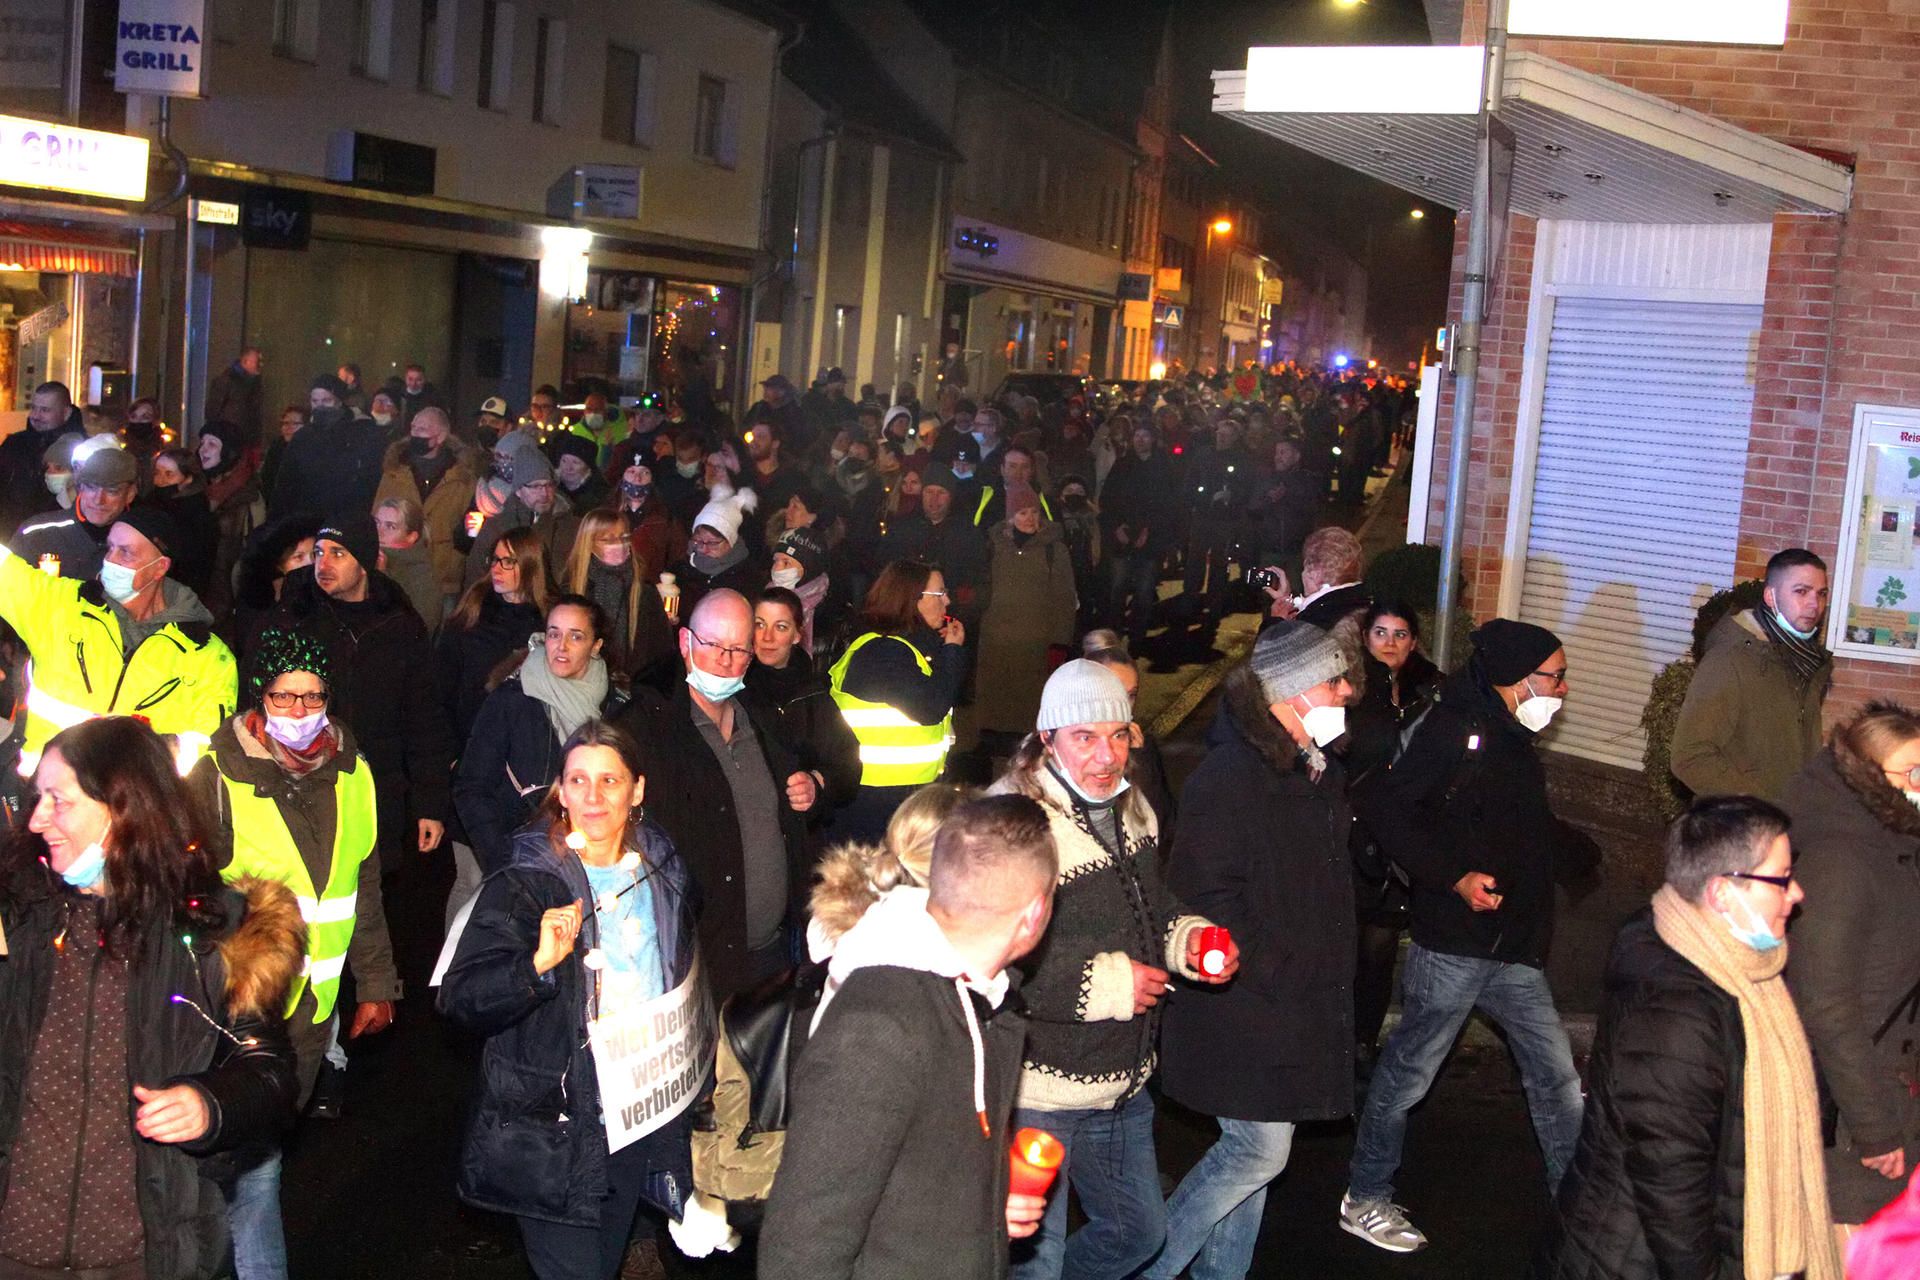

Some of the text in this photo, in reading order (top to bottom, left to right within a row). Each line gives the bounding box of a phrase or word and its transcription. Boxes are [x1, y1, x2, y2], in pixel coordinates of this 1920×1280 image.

[119, 21, 200, 44] KRETA
[122, 50, 194, 72] GRILL
[249, 201, 299, 236] sky
[620, 1058, 698, 1132] verbietet
